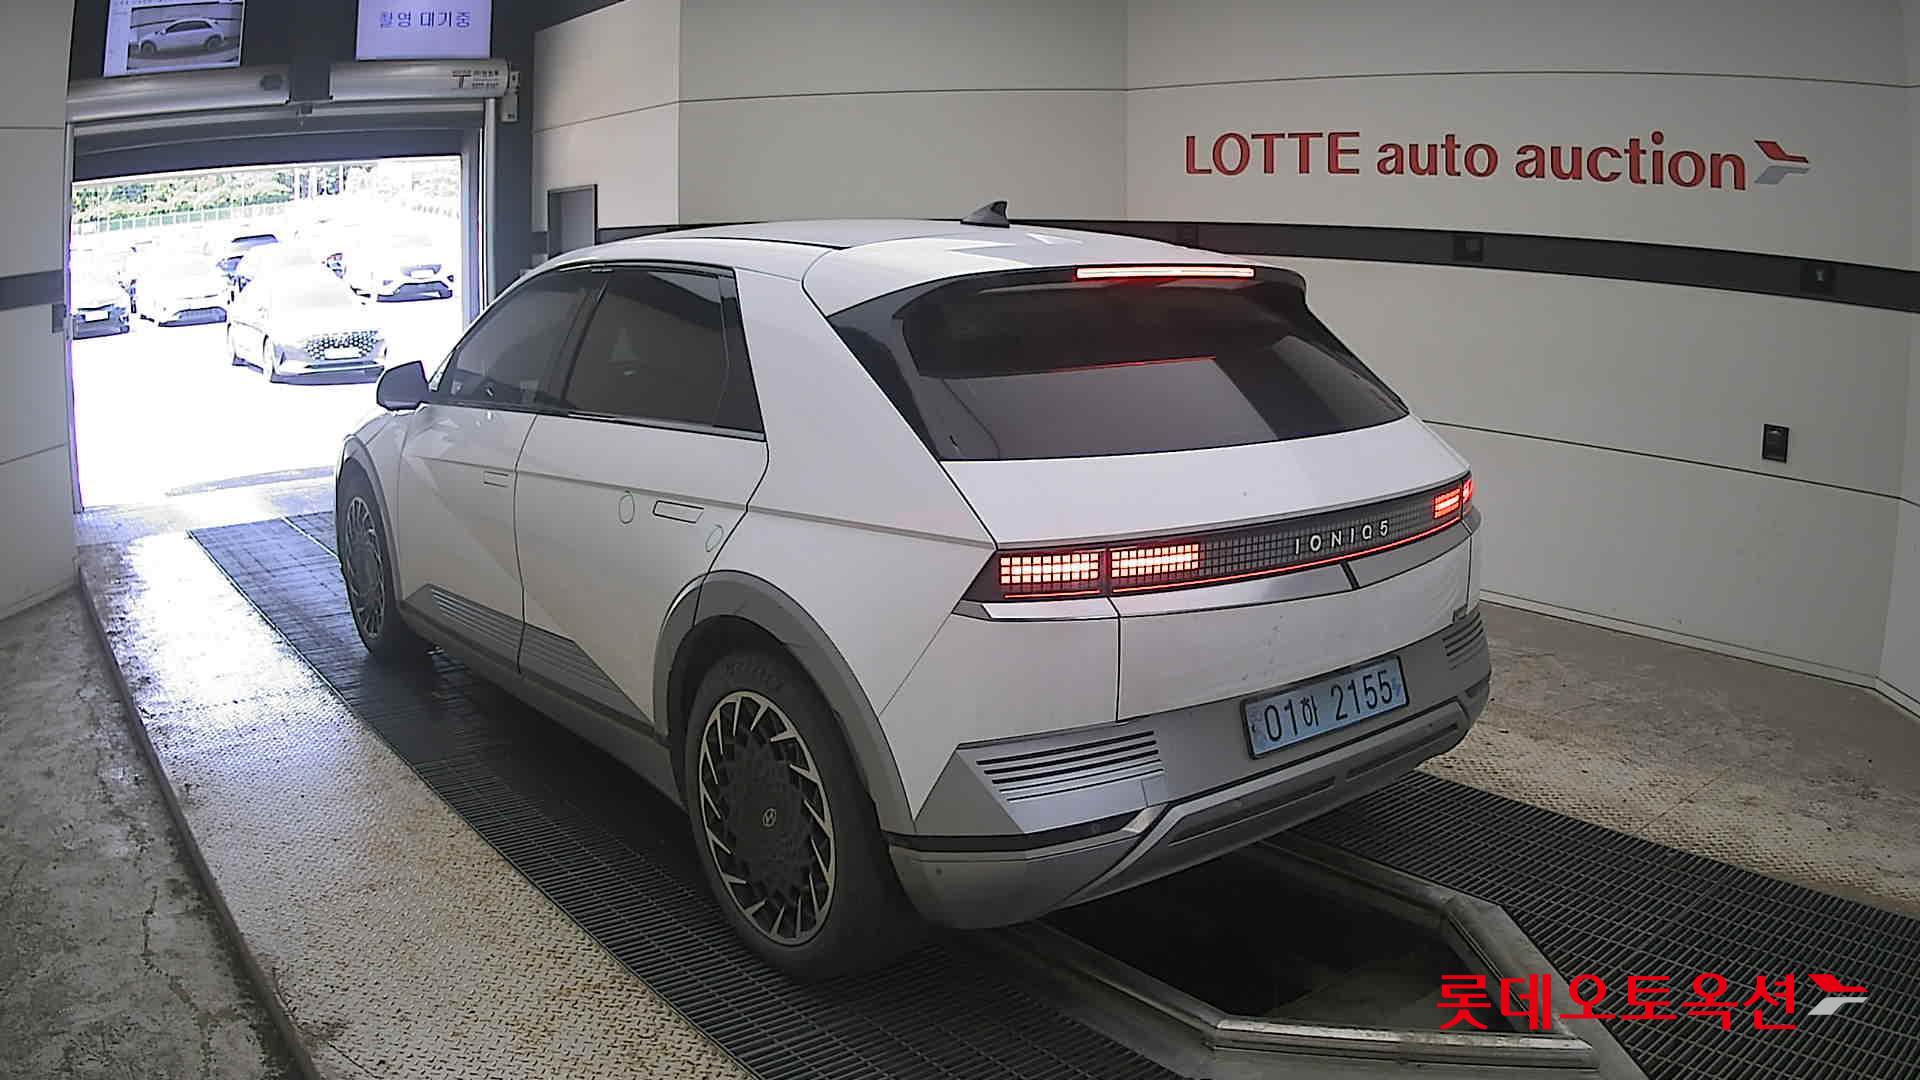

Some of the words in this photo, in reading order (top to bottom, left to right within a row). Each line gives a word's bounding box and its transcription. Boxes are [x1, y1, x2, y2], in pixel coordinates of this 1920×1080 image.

[420, 11, 470, 28] 대기중
[1185, 132, 1360, 176] LOTTE
[1376, 133, 1499, 177] auto
[1515, 131, 1746, 190] auction
[1263, 698, 1319, 741] 01하
[1331, 670, 1393, 721] 2155
